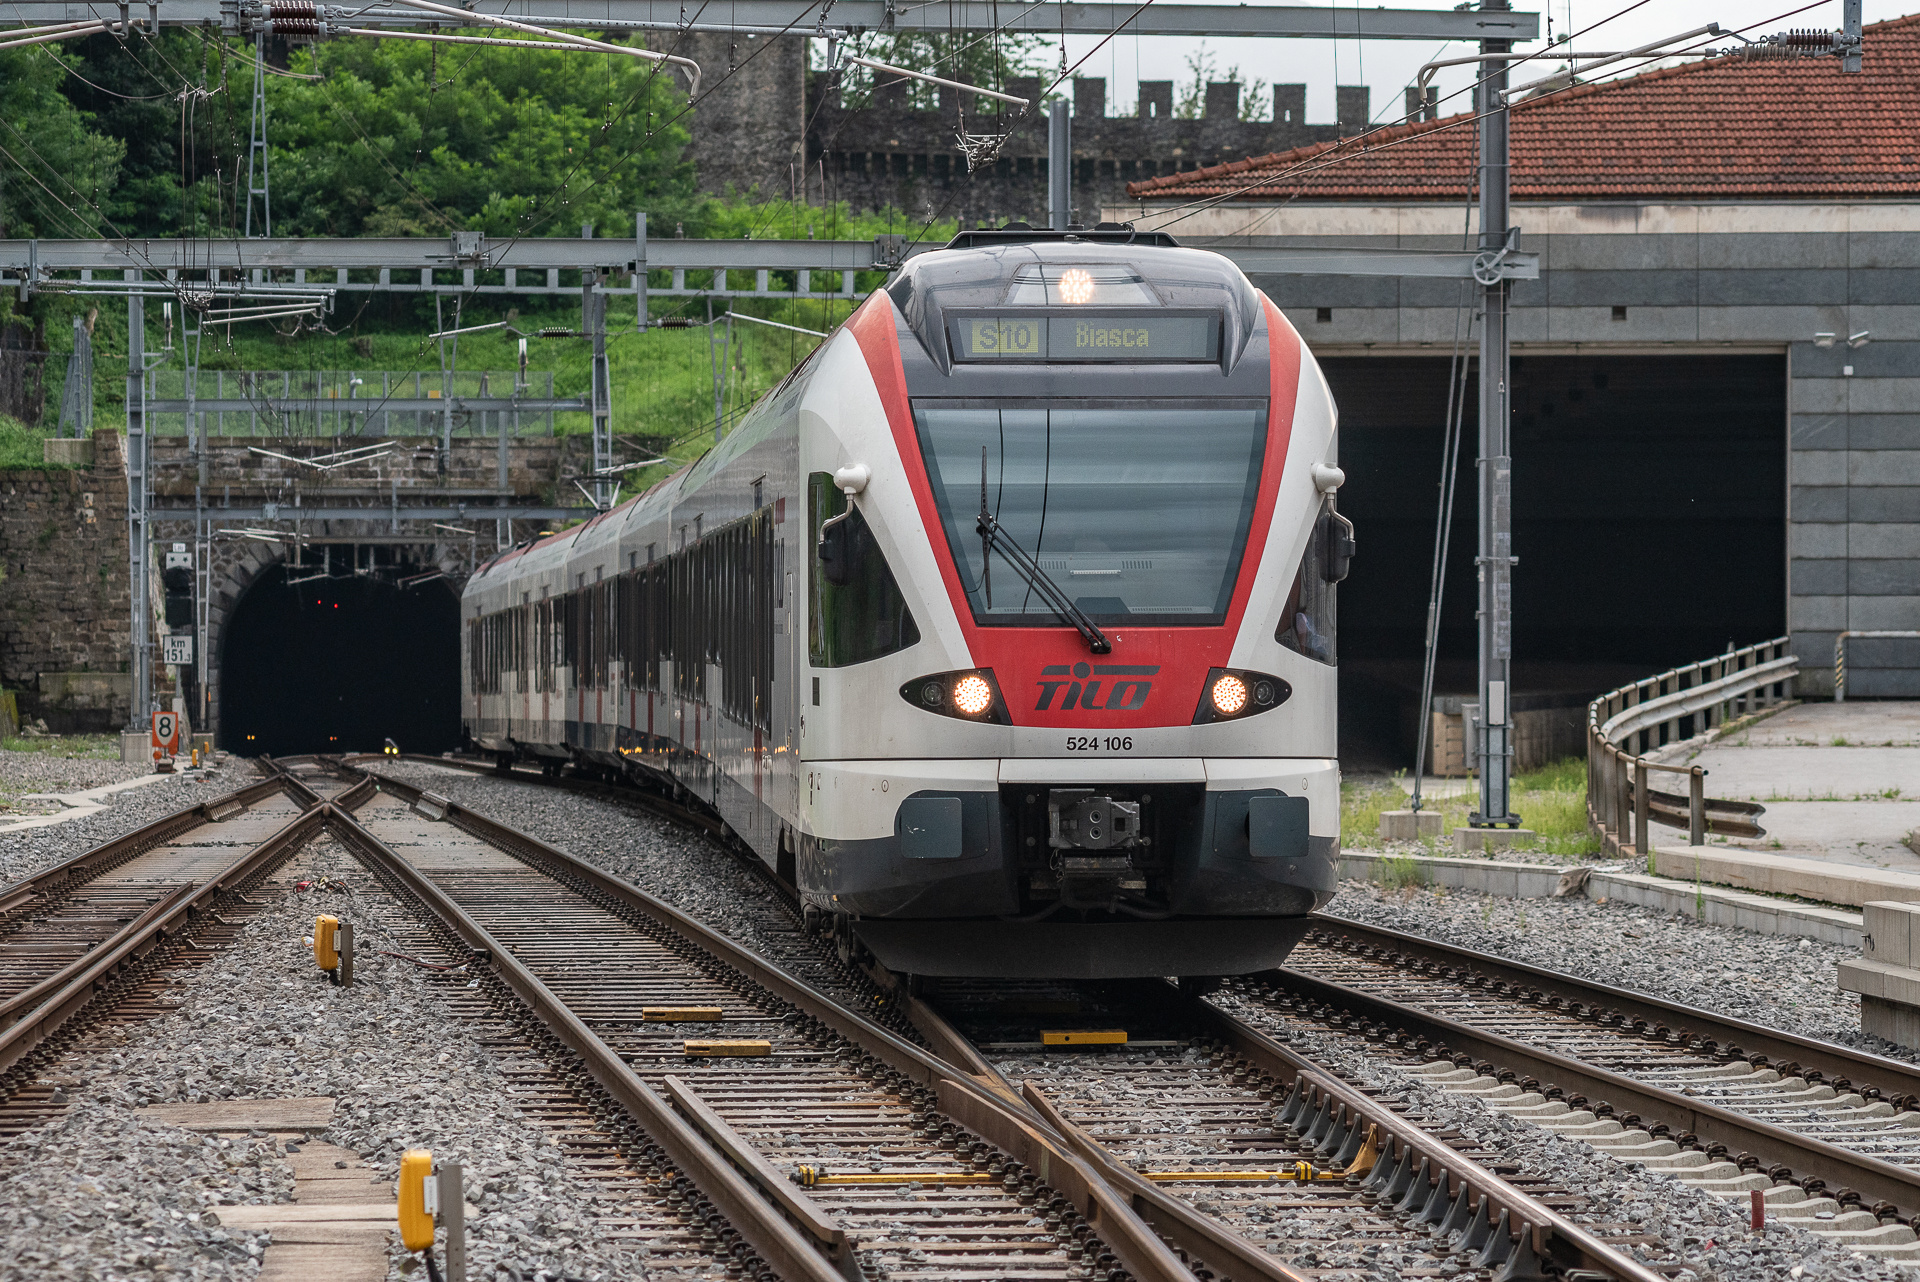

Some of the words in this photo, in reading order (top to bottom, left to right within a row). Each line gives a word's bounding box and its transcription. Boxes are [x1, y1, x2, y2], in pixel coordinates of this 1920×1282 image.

[979, 324, 1031, 350] S10
[1076, 321, 1149, 348] Biasca
[170, 637, 186, 648] km
[158, 716, 171, 737] 8
[1066, 736, 1099, 751] 524
[1103, 736, 1133, 751] 106
